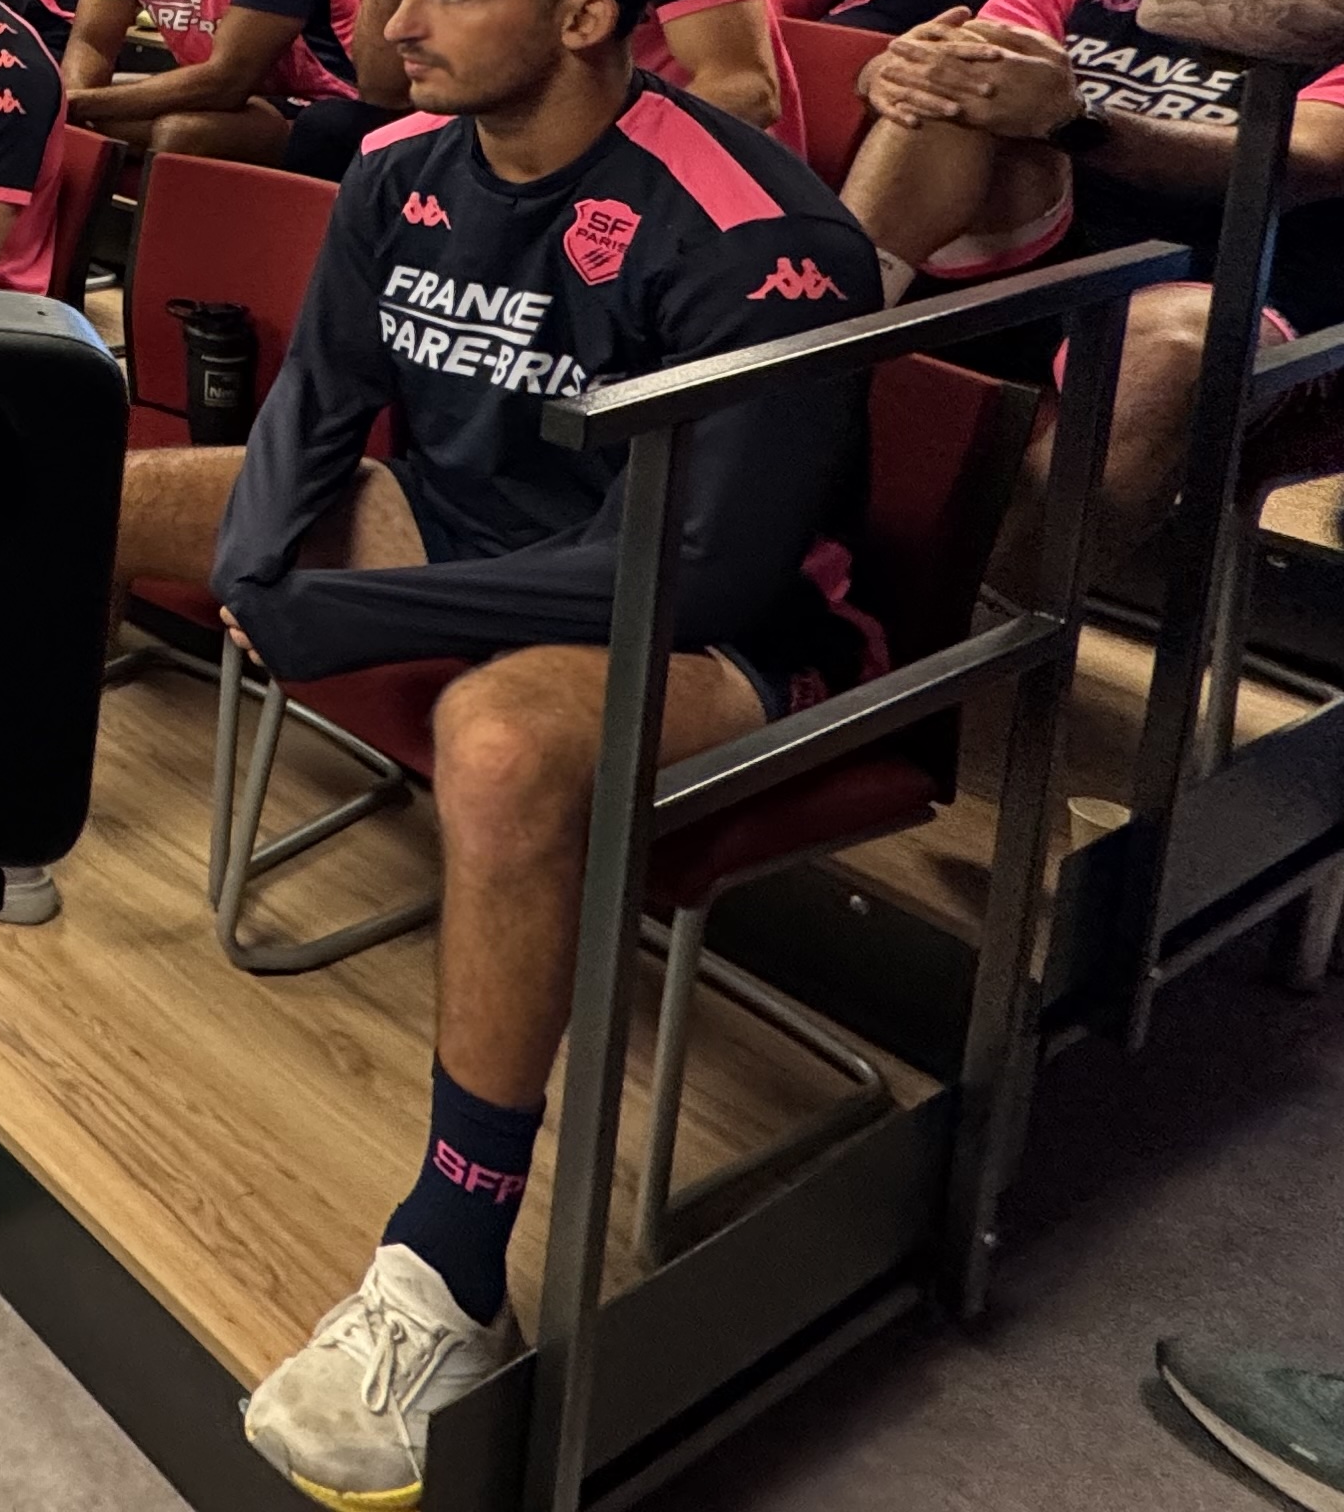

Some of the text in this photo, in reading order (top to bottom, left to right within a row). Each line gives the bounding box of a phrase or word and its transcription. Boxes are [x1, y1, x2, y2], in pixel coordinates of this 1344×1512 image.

[575, 227, 629, 253] PARIS
[587, 210, 634, 235] SF
[384, 264, 553, 333] FRANCE
[378, 310, 593, 398] PARE-BRIS
[433, 1138, 528, 1205] SFP
